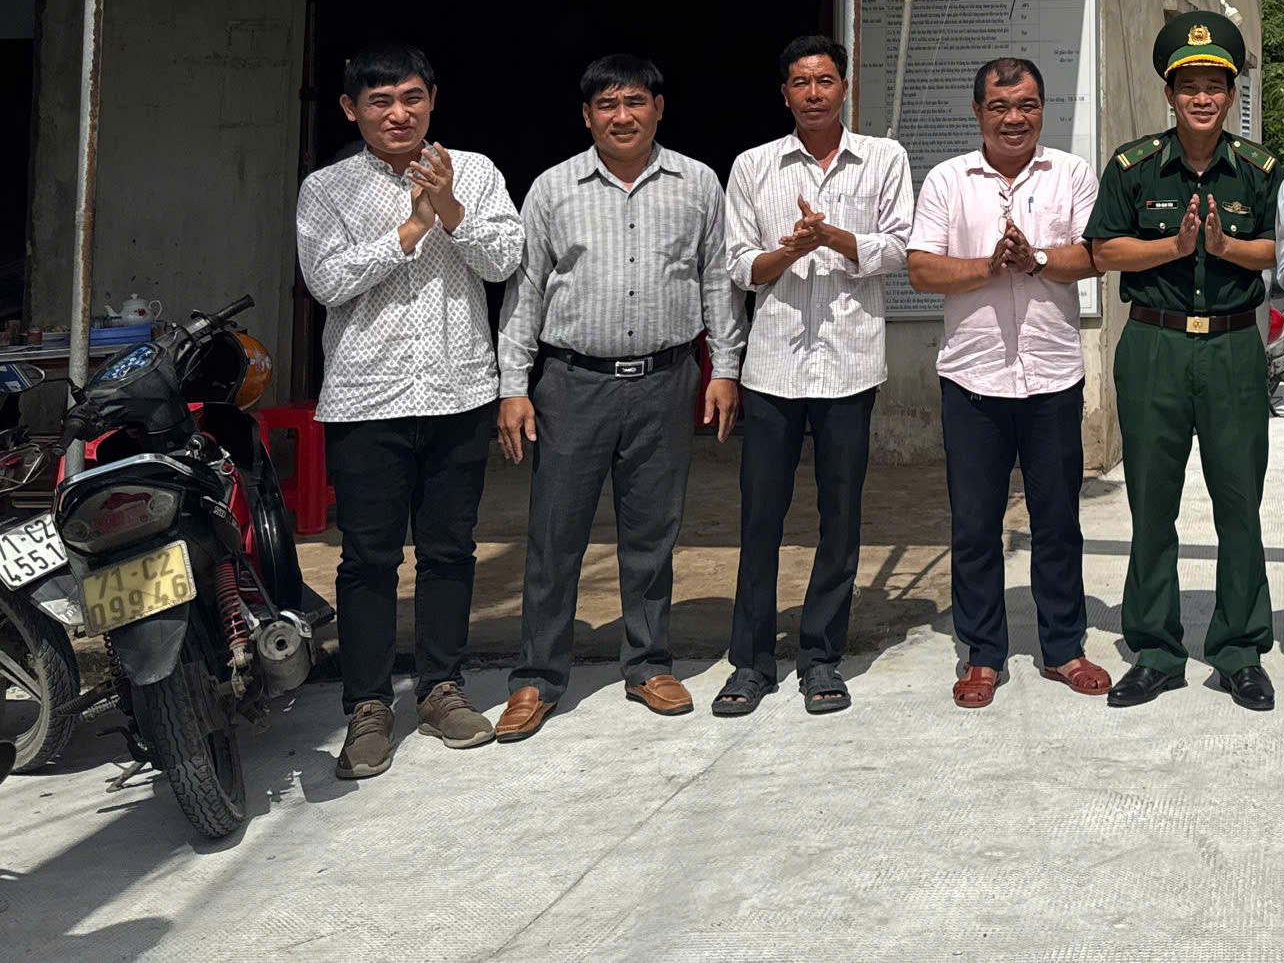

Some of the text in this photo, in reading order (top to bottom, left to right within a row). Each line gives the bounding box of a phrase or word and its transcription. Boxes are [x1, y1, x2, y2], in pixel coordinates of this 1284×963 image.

[3, 542, 65, 582] 455.1
[94, 548, 174, 599] 71-C2
[89, 574, 188, 631] 099.46
